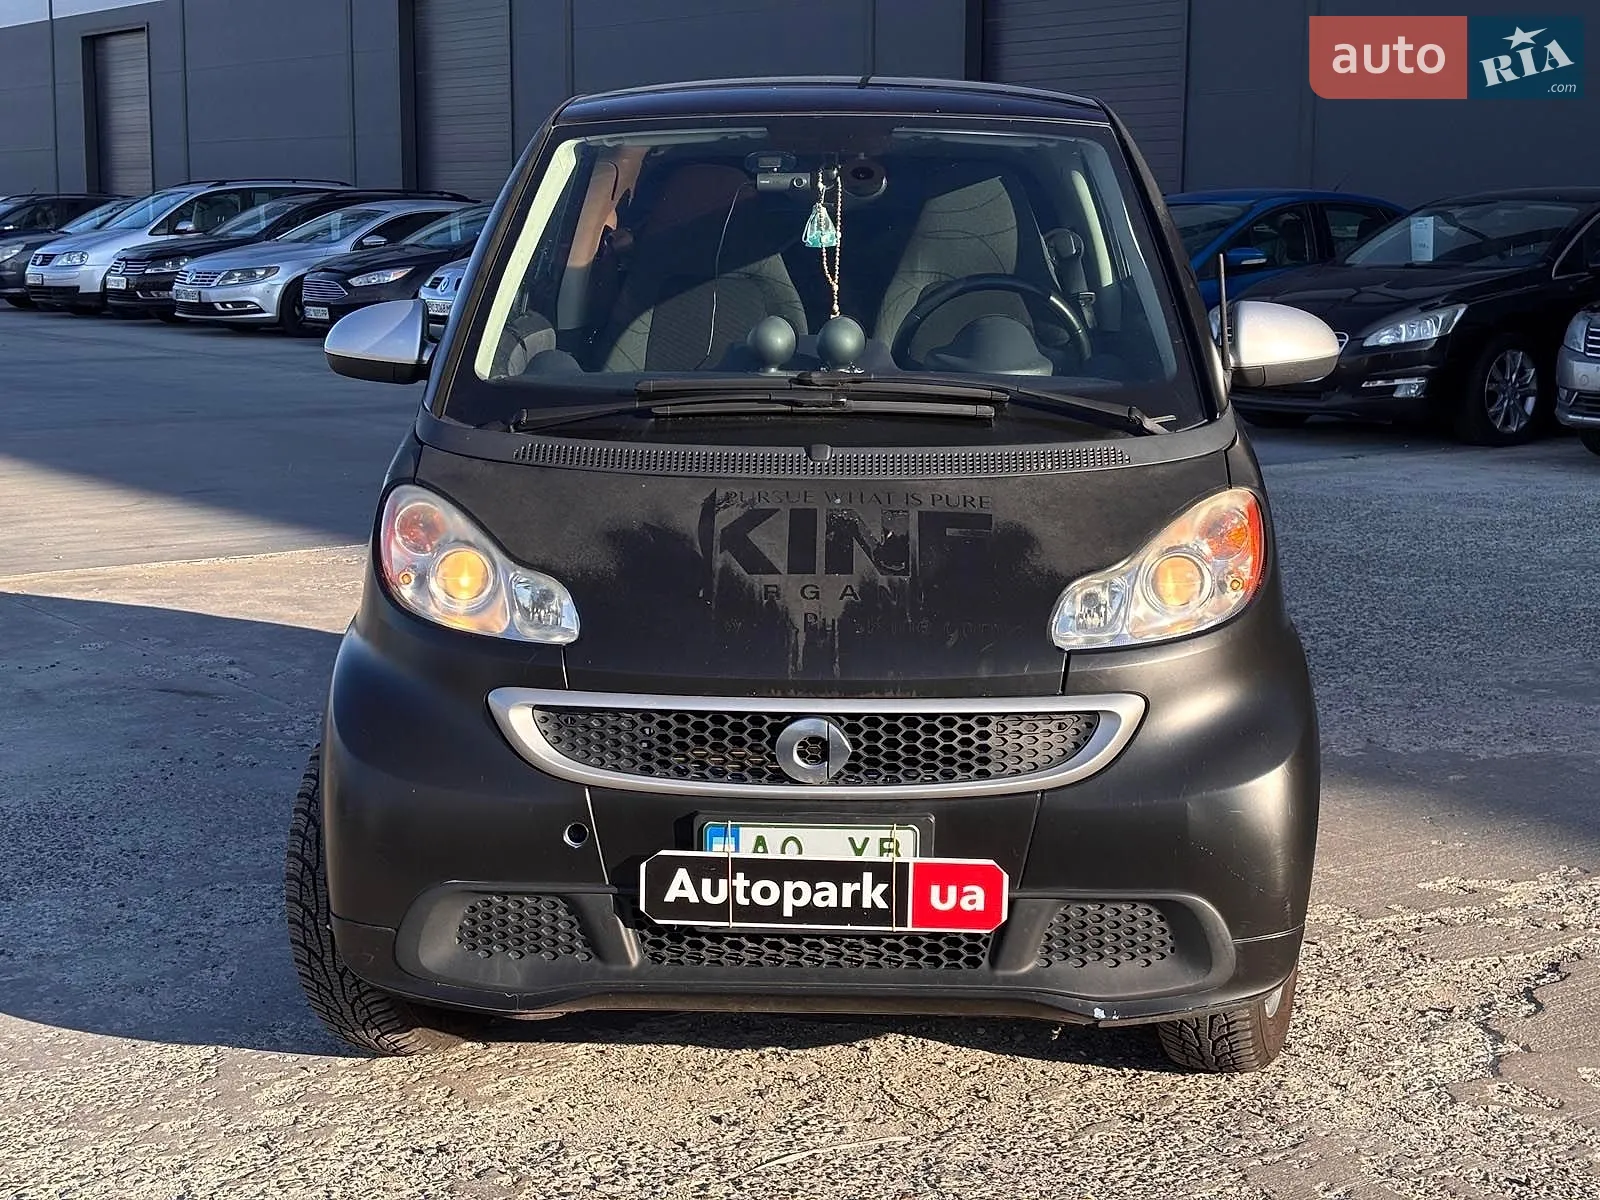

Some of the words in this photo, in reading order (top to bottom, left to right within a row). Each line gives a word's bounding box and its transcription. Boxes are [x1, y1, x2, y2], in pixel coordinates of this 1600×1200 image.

[825, 490, 895, 505] WHAT
[905, 491, 923, 506] IS
[930, 493, 993, 509] PURE
[663, 867, 890, 918] Autopark
[929, 882, 986, 913] ua
